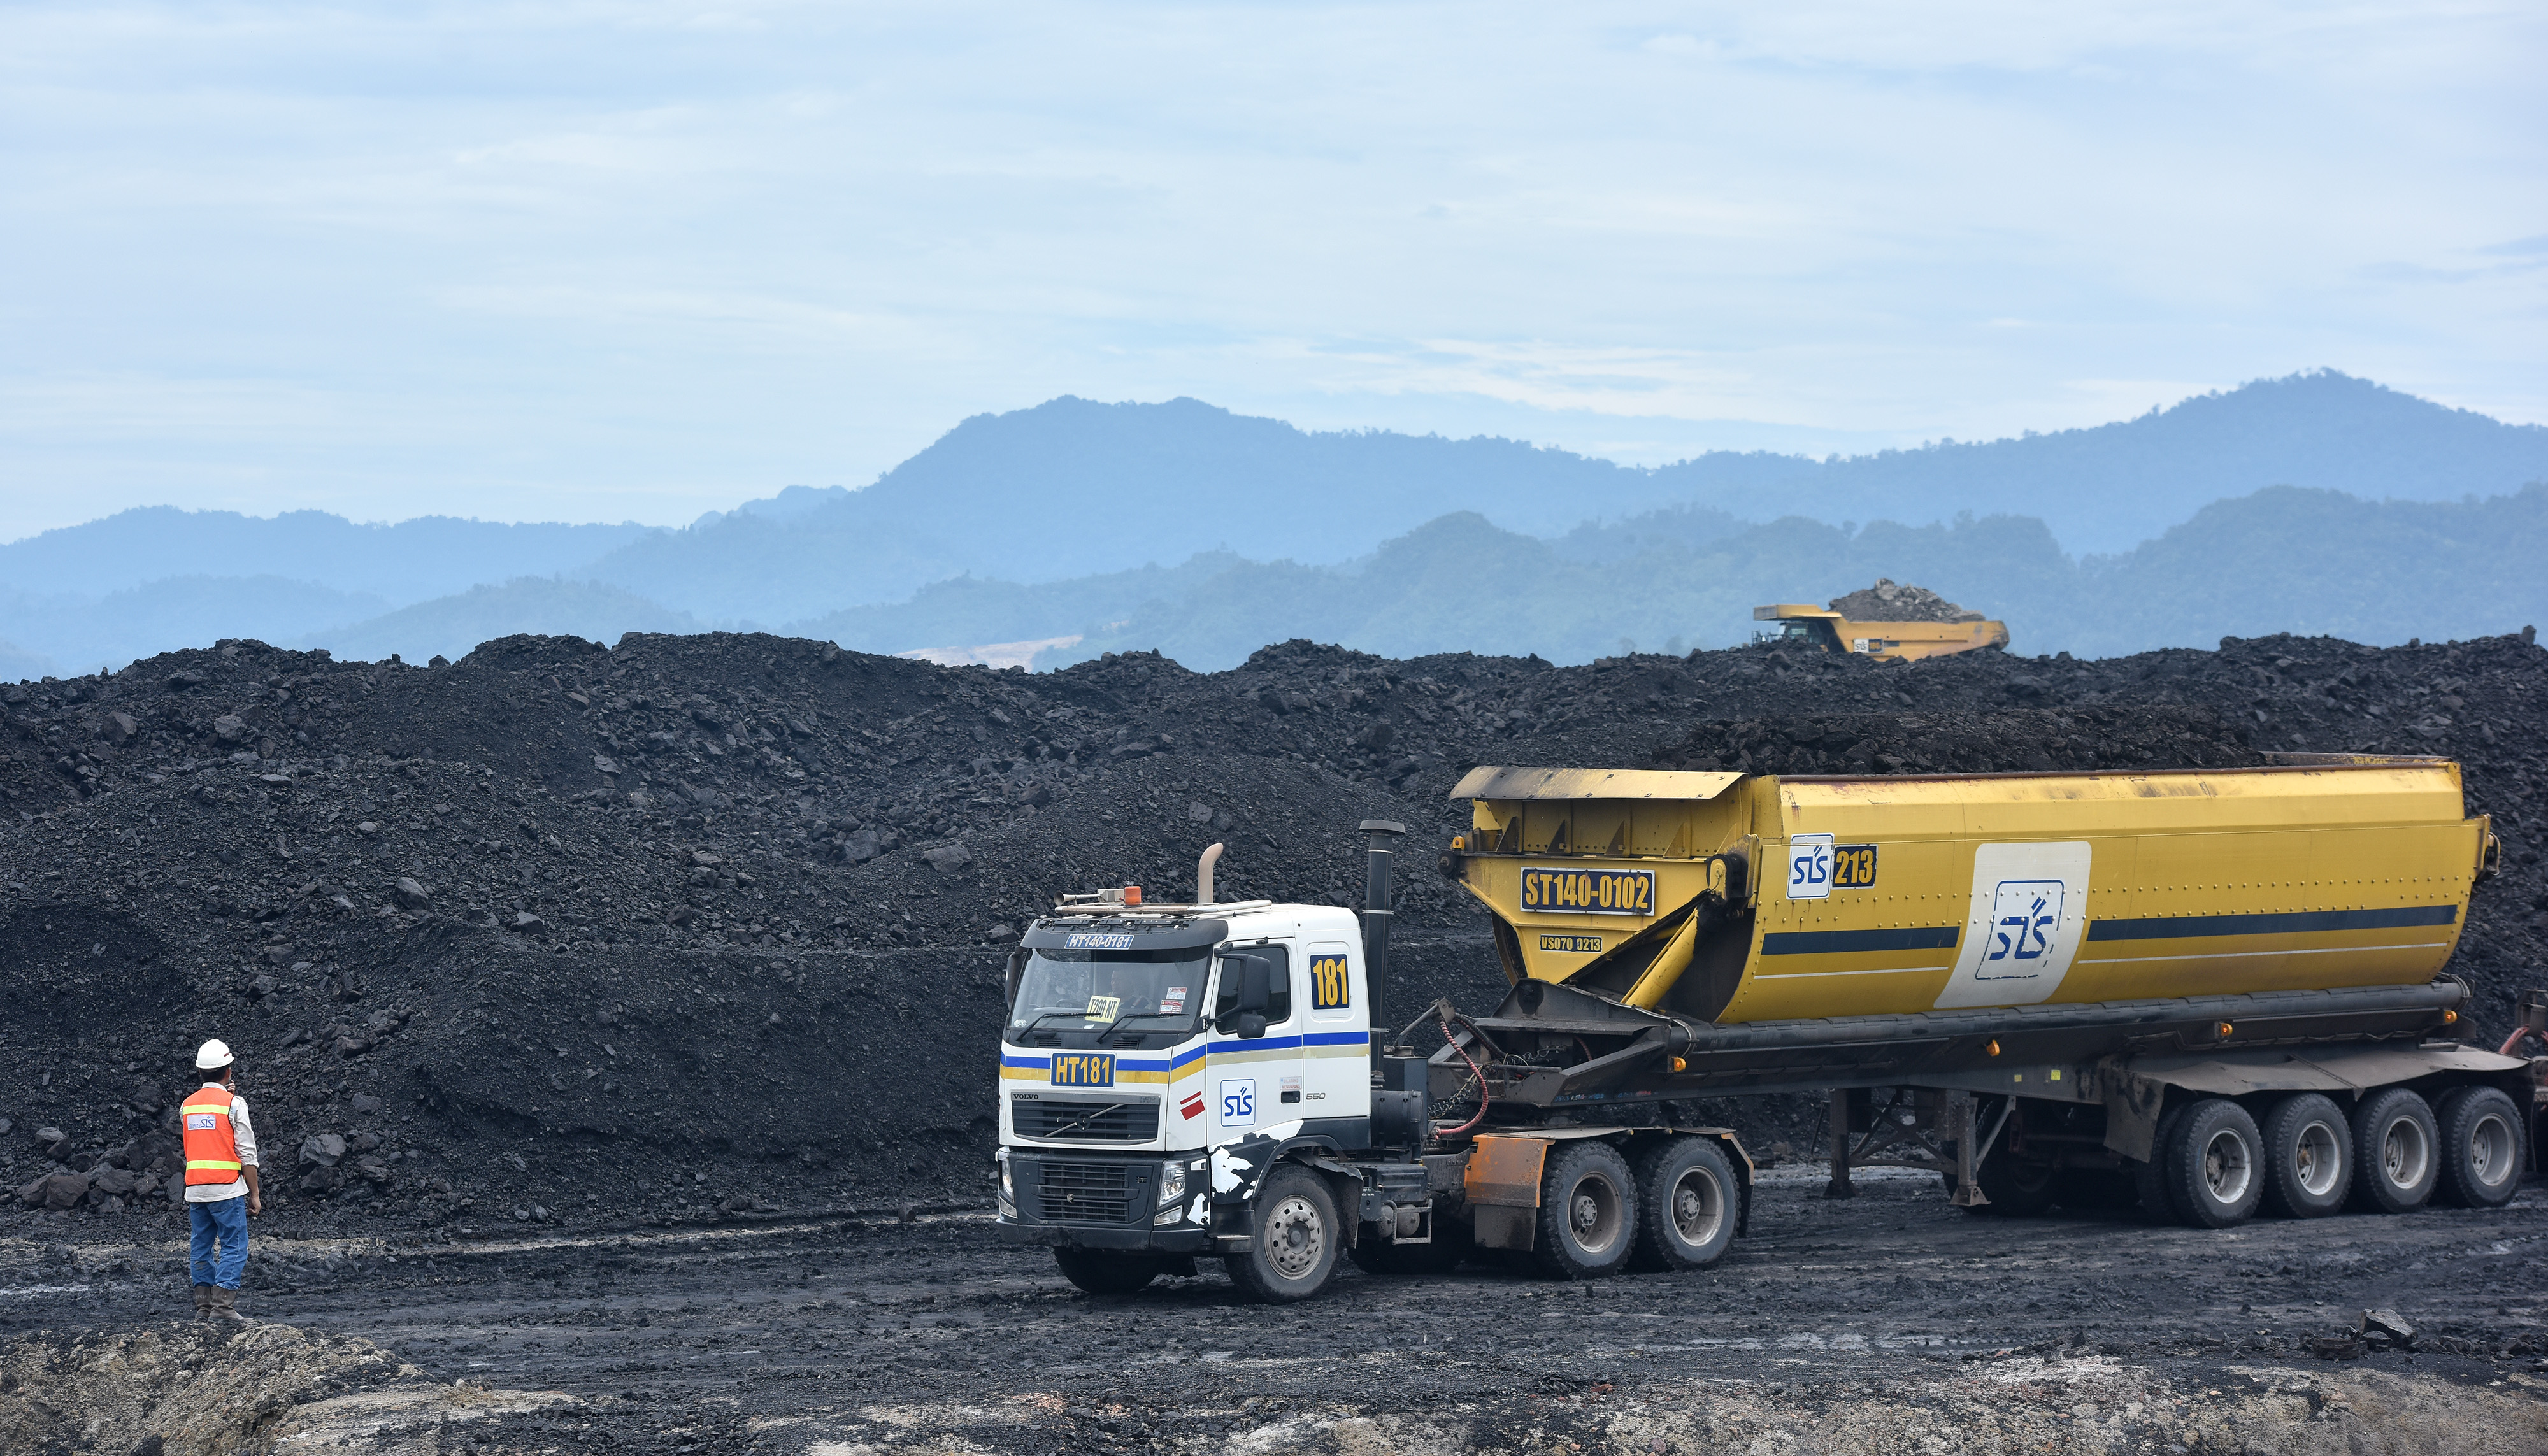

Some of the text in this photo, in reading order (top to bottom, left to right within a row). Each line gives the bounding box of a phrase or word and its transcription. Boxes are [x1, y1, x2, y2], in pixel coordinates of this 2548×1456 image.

[1835, 850, 1873, 884] 213
[1526, 873, 1649, 909] ST140-0102
[1068, 936, 1131, 948] HT140-0181
[1542, 936, 1600, 951] VS070 0213
[1313, 958, 1348, 1006] 181
[1104, 1000, 1117, 1019] NT
[1056, 1057, 1110, 1083] HT181
